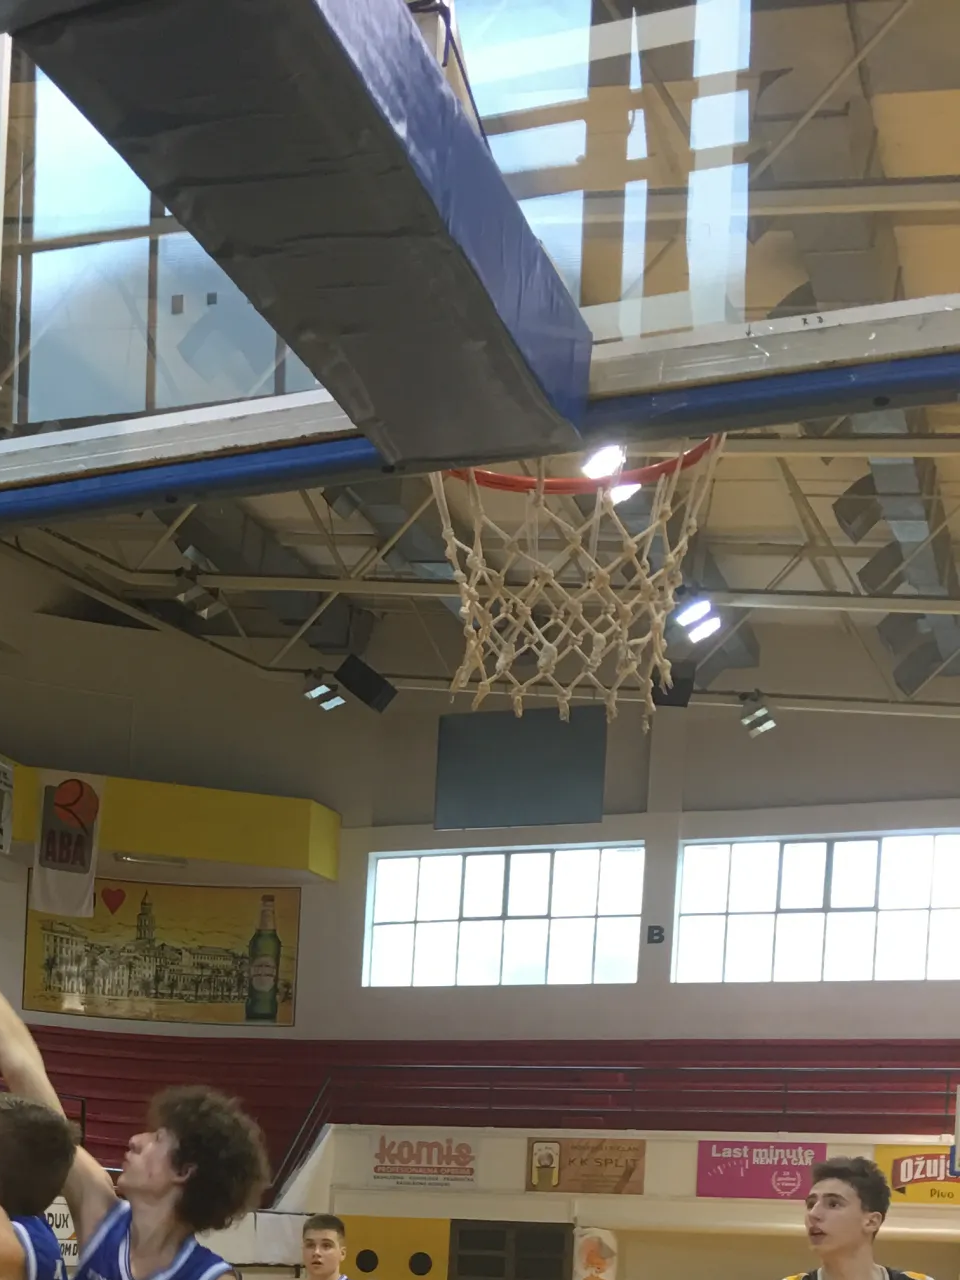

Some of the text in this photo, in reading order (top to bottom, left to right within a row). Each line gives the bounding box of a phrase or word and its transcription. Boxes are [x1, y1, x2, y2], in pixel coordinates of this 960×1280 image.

[44, 828, 87, 867] ABA
[646, 924, 665, 944] B
[374, 1134, 476, 1167] komis
[711, 1144, 815, 1161] Last minute
[929, 1187, 955, 1199] Pivo
